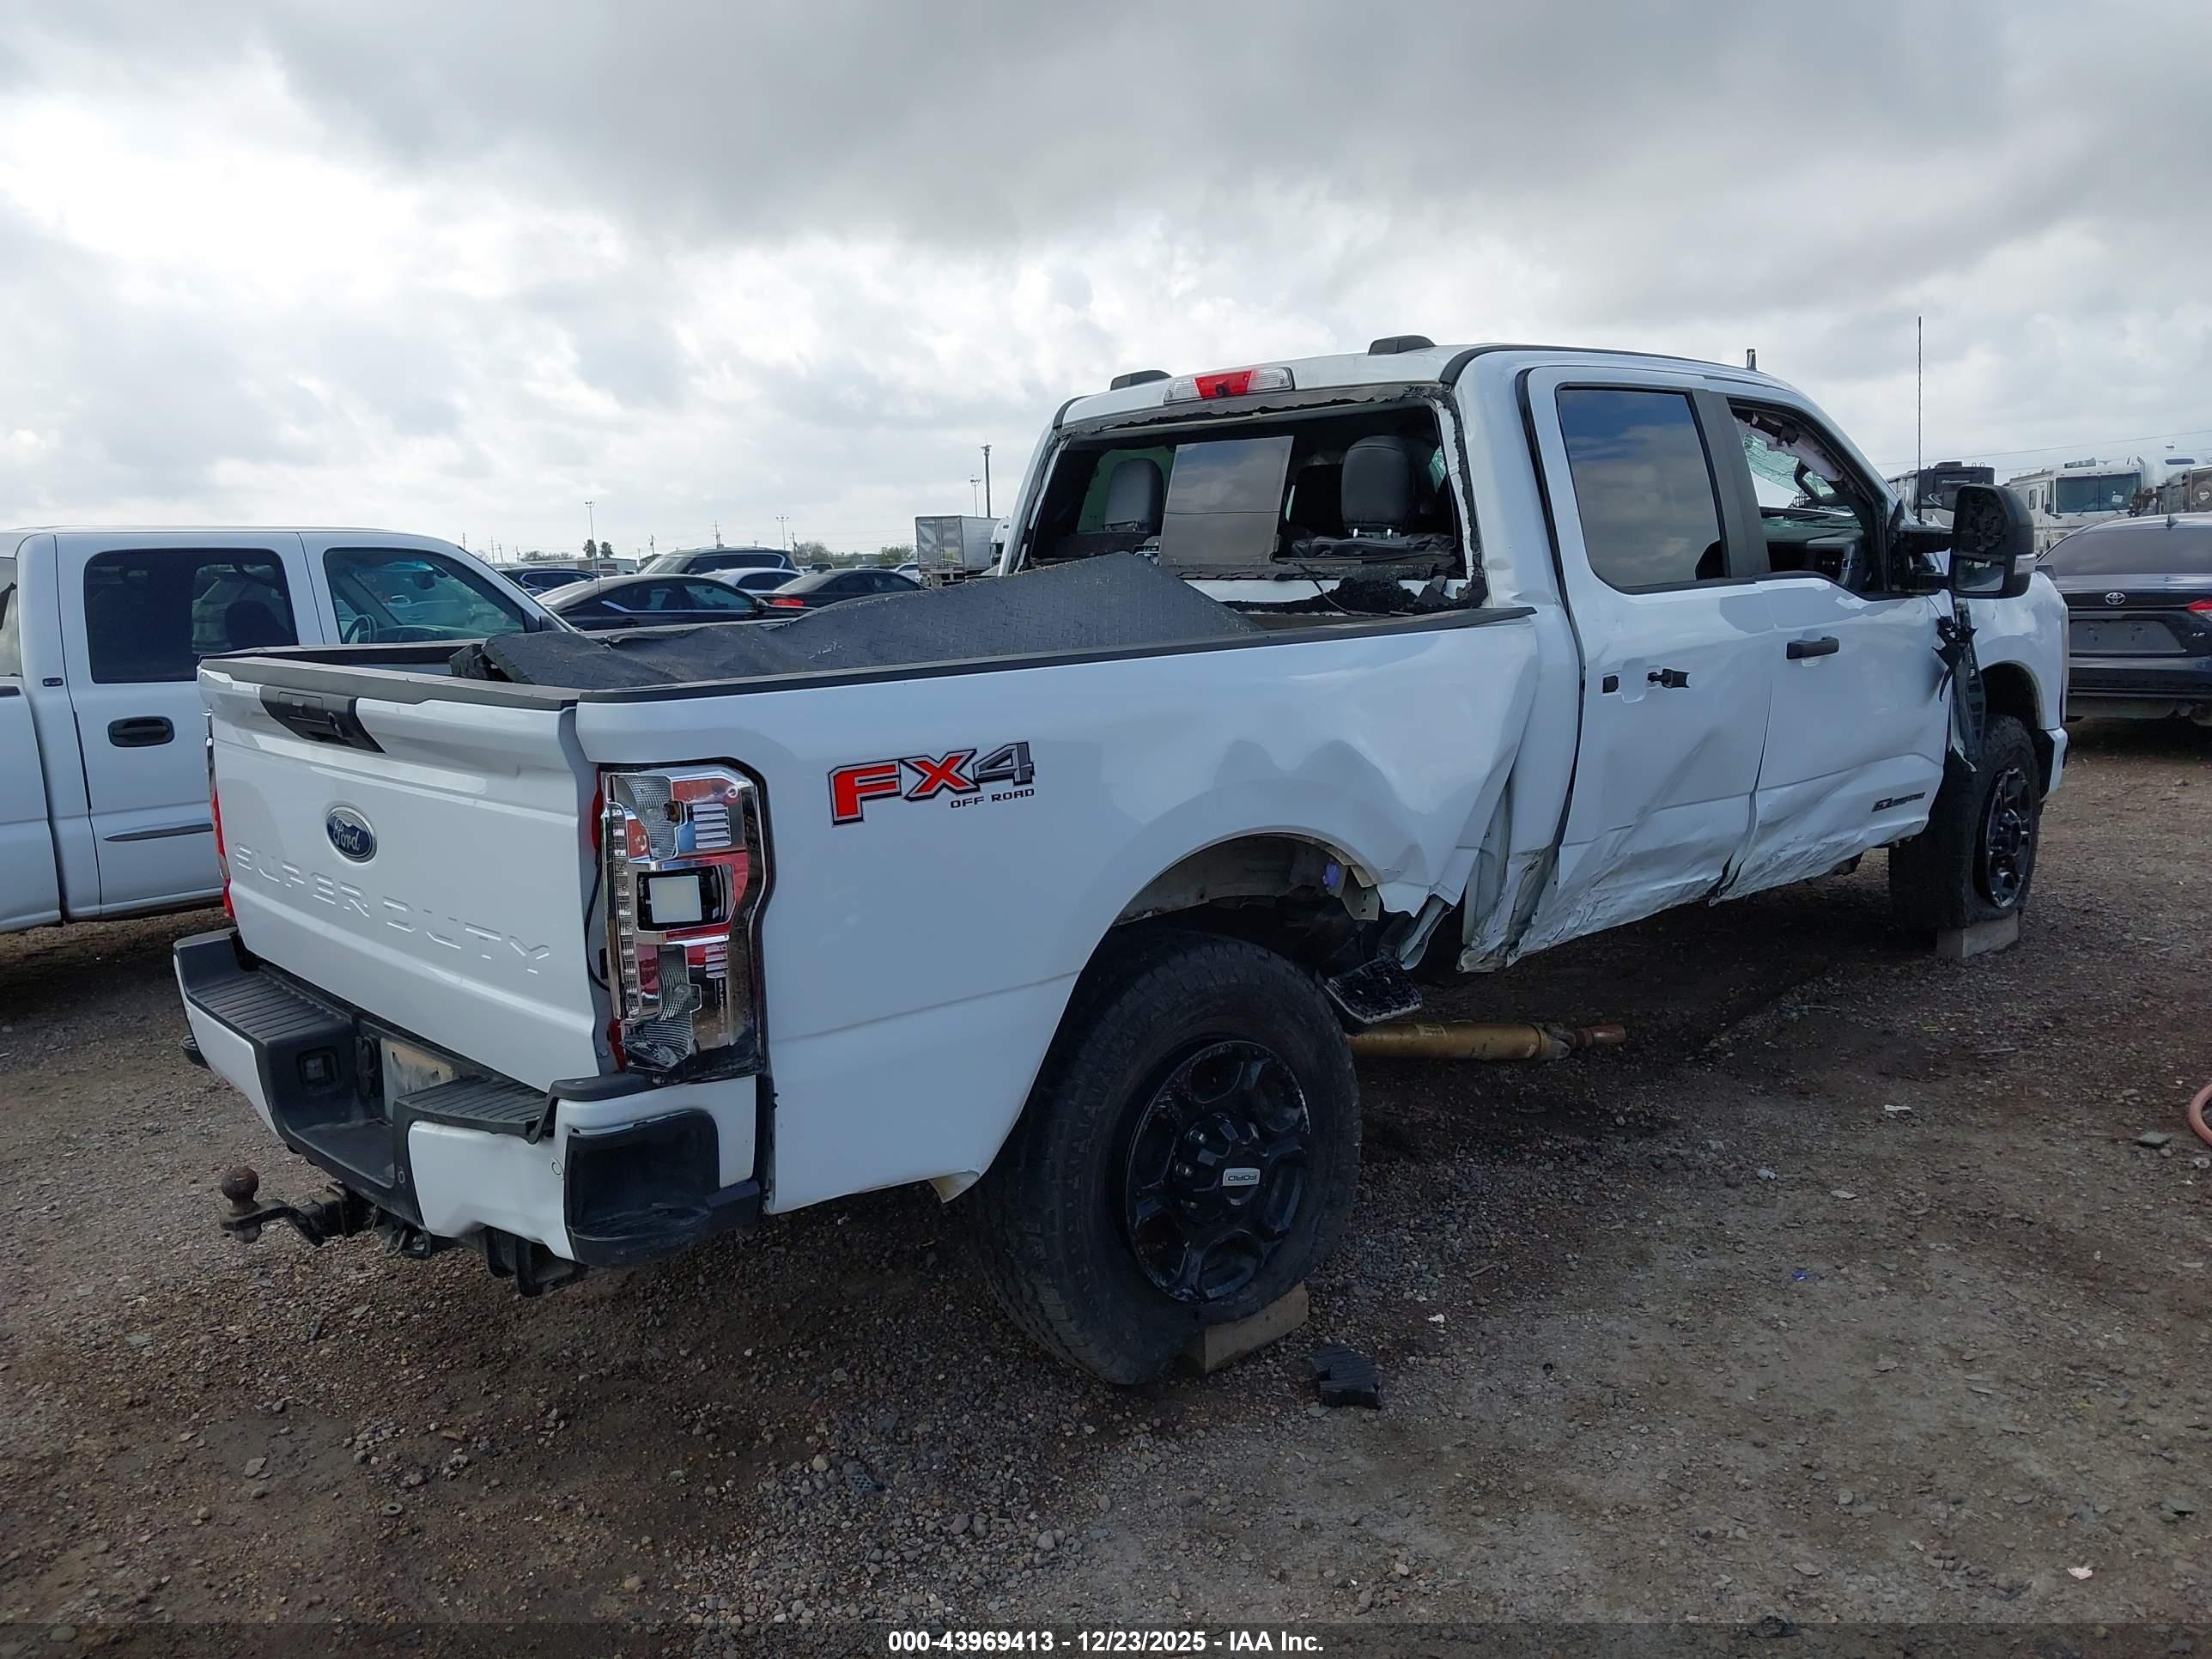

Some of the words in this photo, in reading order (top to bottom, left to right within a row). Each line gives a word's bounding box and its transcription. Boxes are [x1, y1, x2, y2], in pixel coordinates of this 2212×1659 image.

[828, 741, 1035, 826] FX4
[950, 795, 985, 809] OFF
[991, 788, 1035, 802] ROAD
[332, 817, 361, 852] Ford
[234, 842, 370, 918] SUPER
[382, 896, 550, 975] DUTY
